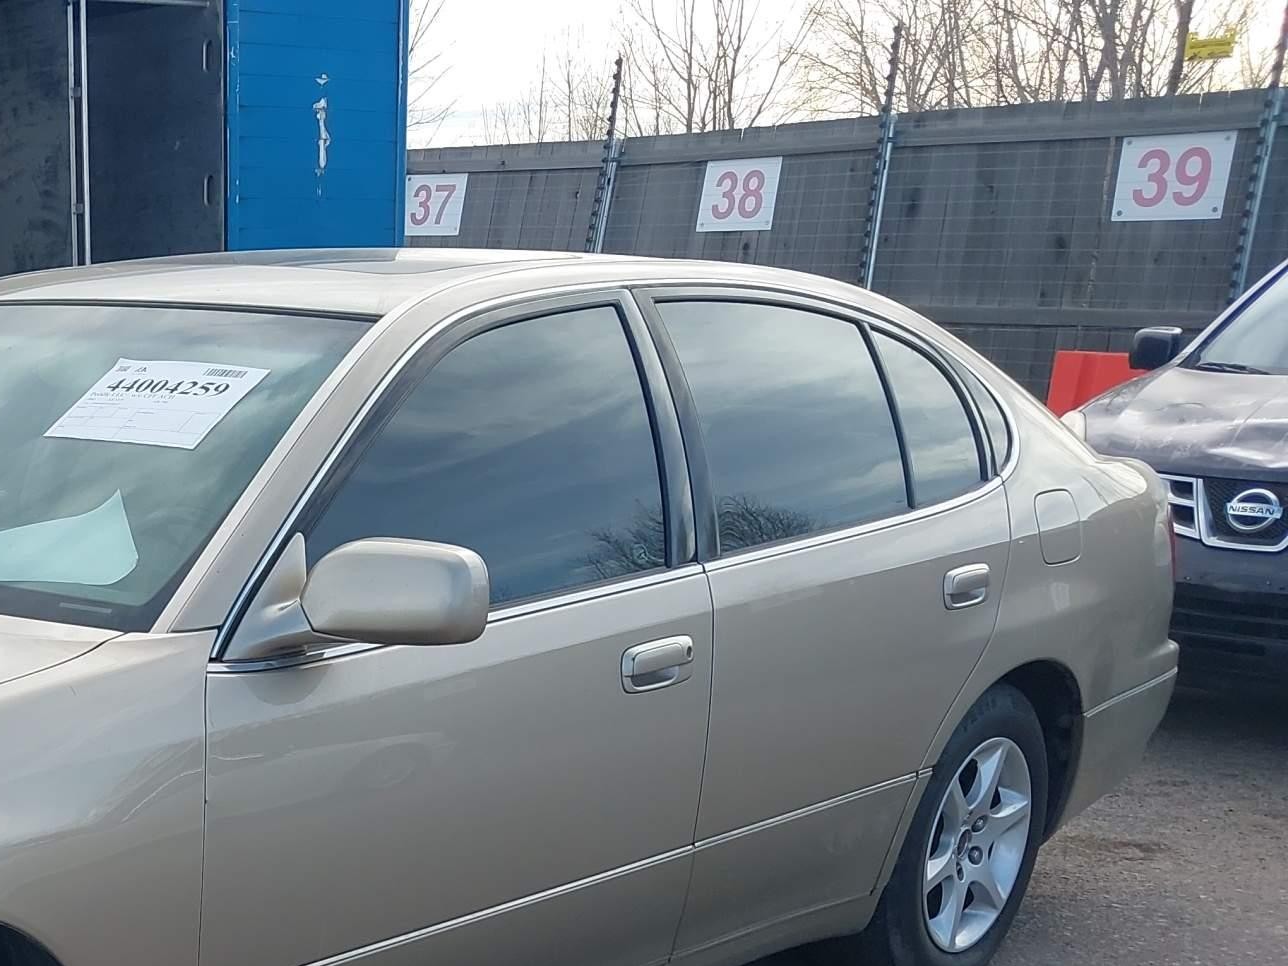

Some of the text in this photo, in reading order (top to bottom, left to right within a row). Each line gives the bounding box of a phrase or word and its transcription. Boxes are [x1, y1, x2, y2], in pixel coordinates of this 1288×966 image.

[712, 170, 765, 220] 38
[1132, 147, 1213, 207] 39
[410, 184, 457, 226] 37
[106, 378, 232, 397] 44004259
[1228, 505, 1275, 516] NISSAN
